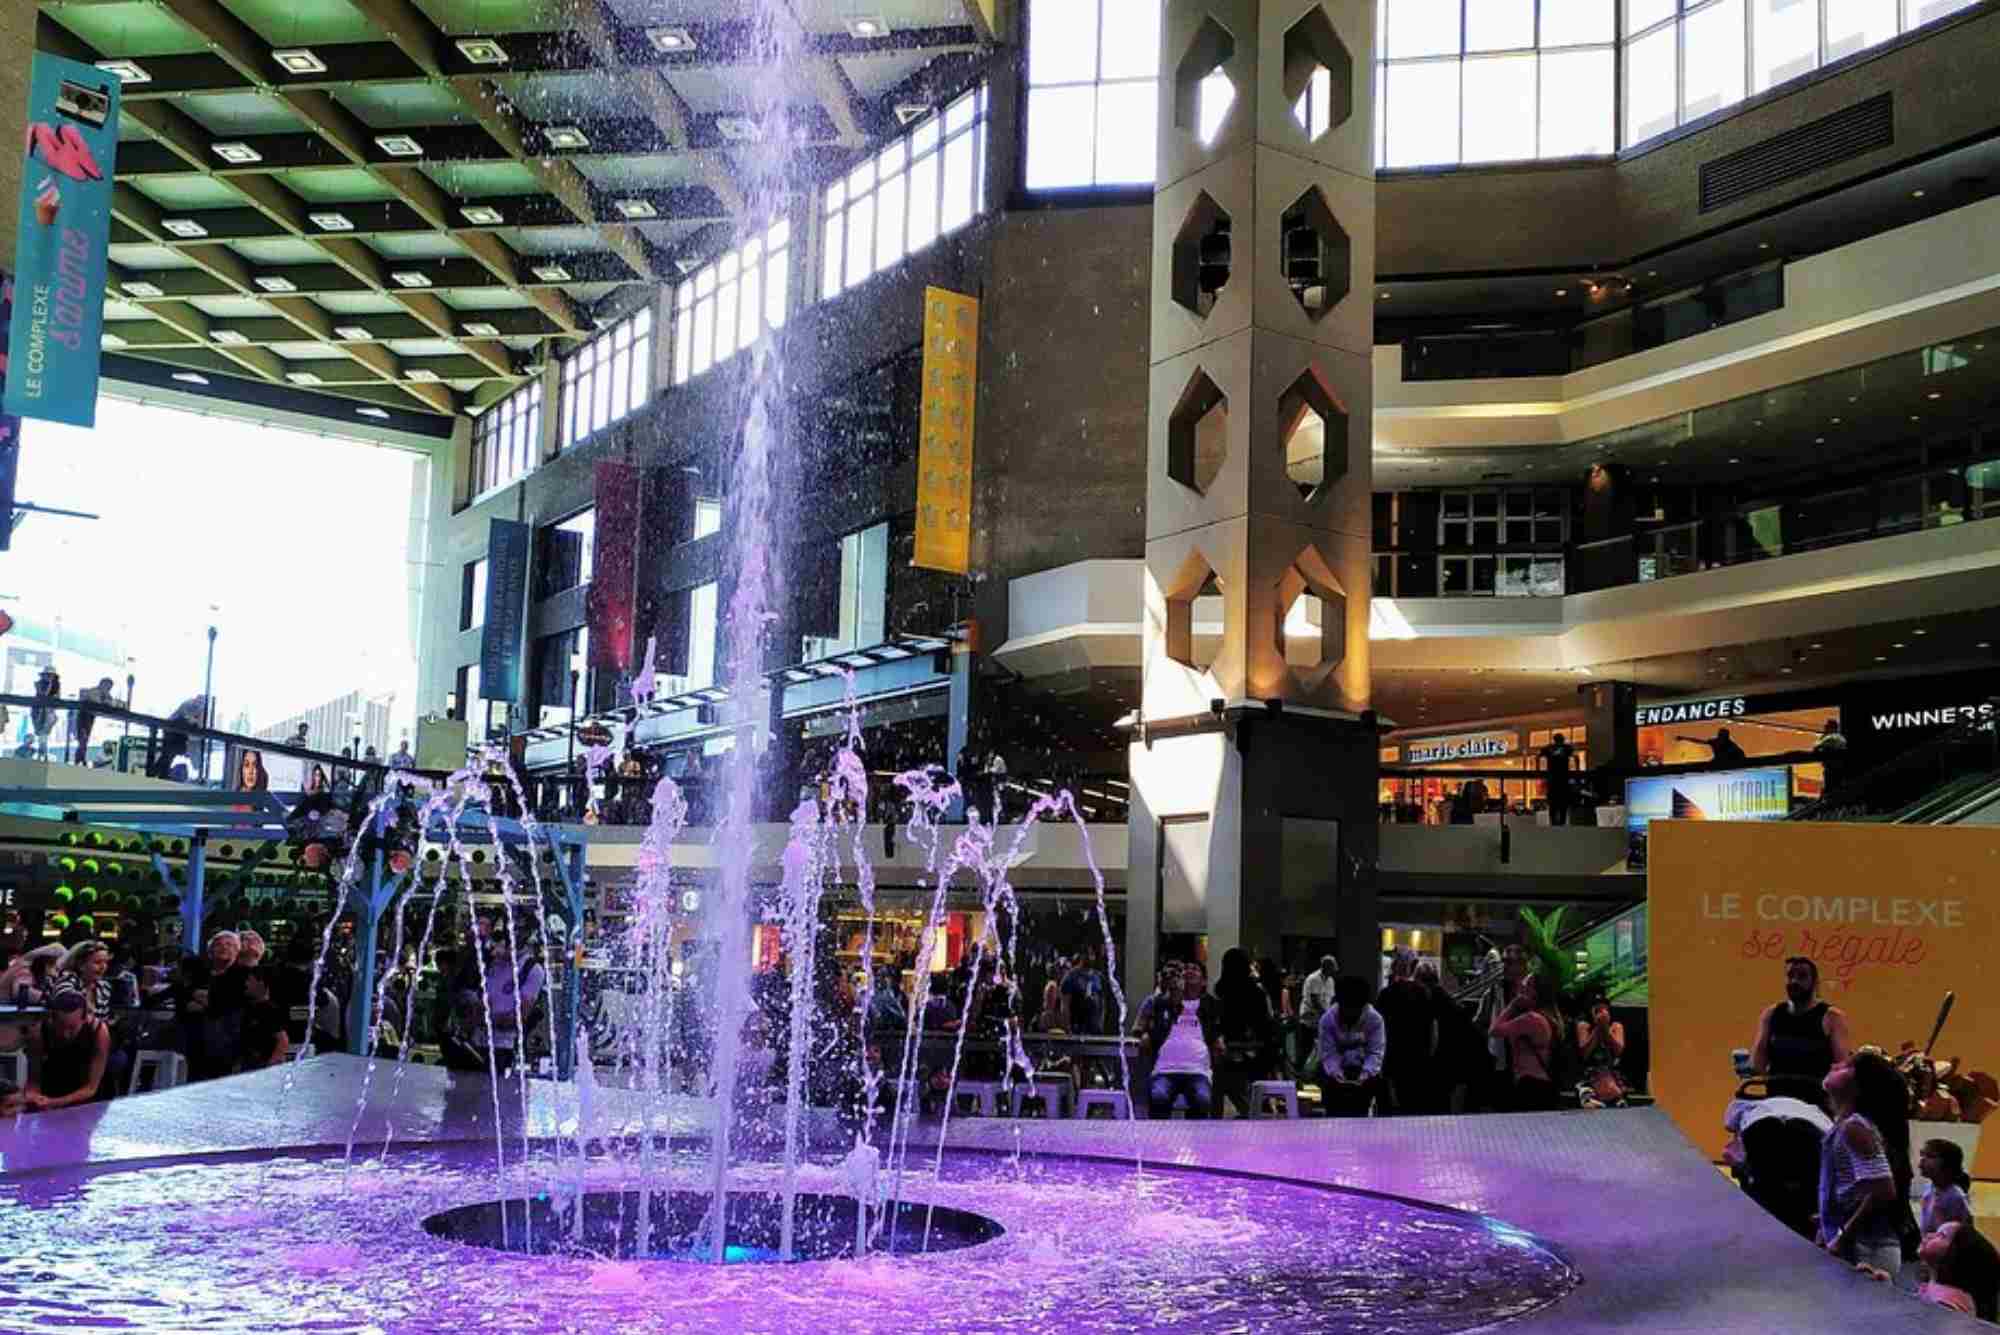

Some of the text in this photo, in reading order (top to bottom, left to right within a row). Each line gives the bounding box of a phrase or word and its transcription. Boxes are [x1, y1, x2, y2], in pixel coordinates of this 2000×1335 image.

[26, 283, 50, 399] LE COMPLEXE
[1408, 737, 1508, 763] marie claire
[1703, 893, 1967, 928] LE COMPLEXE
[1741, 925, 1927, 978] se régale
